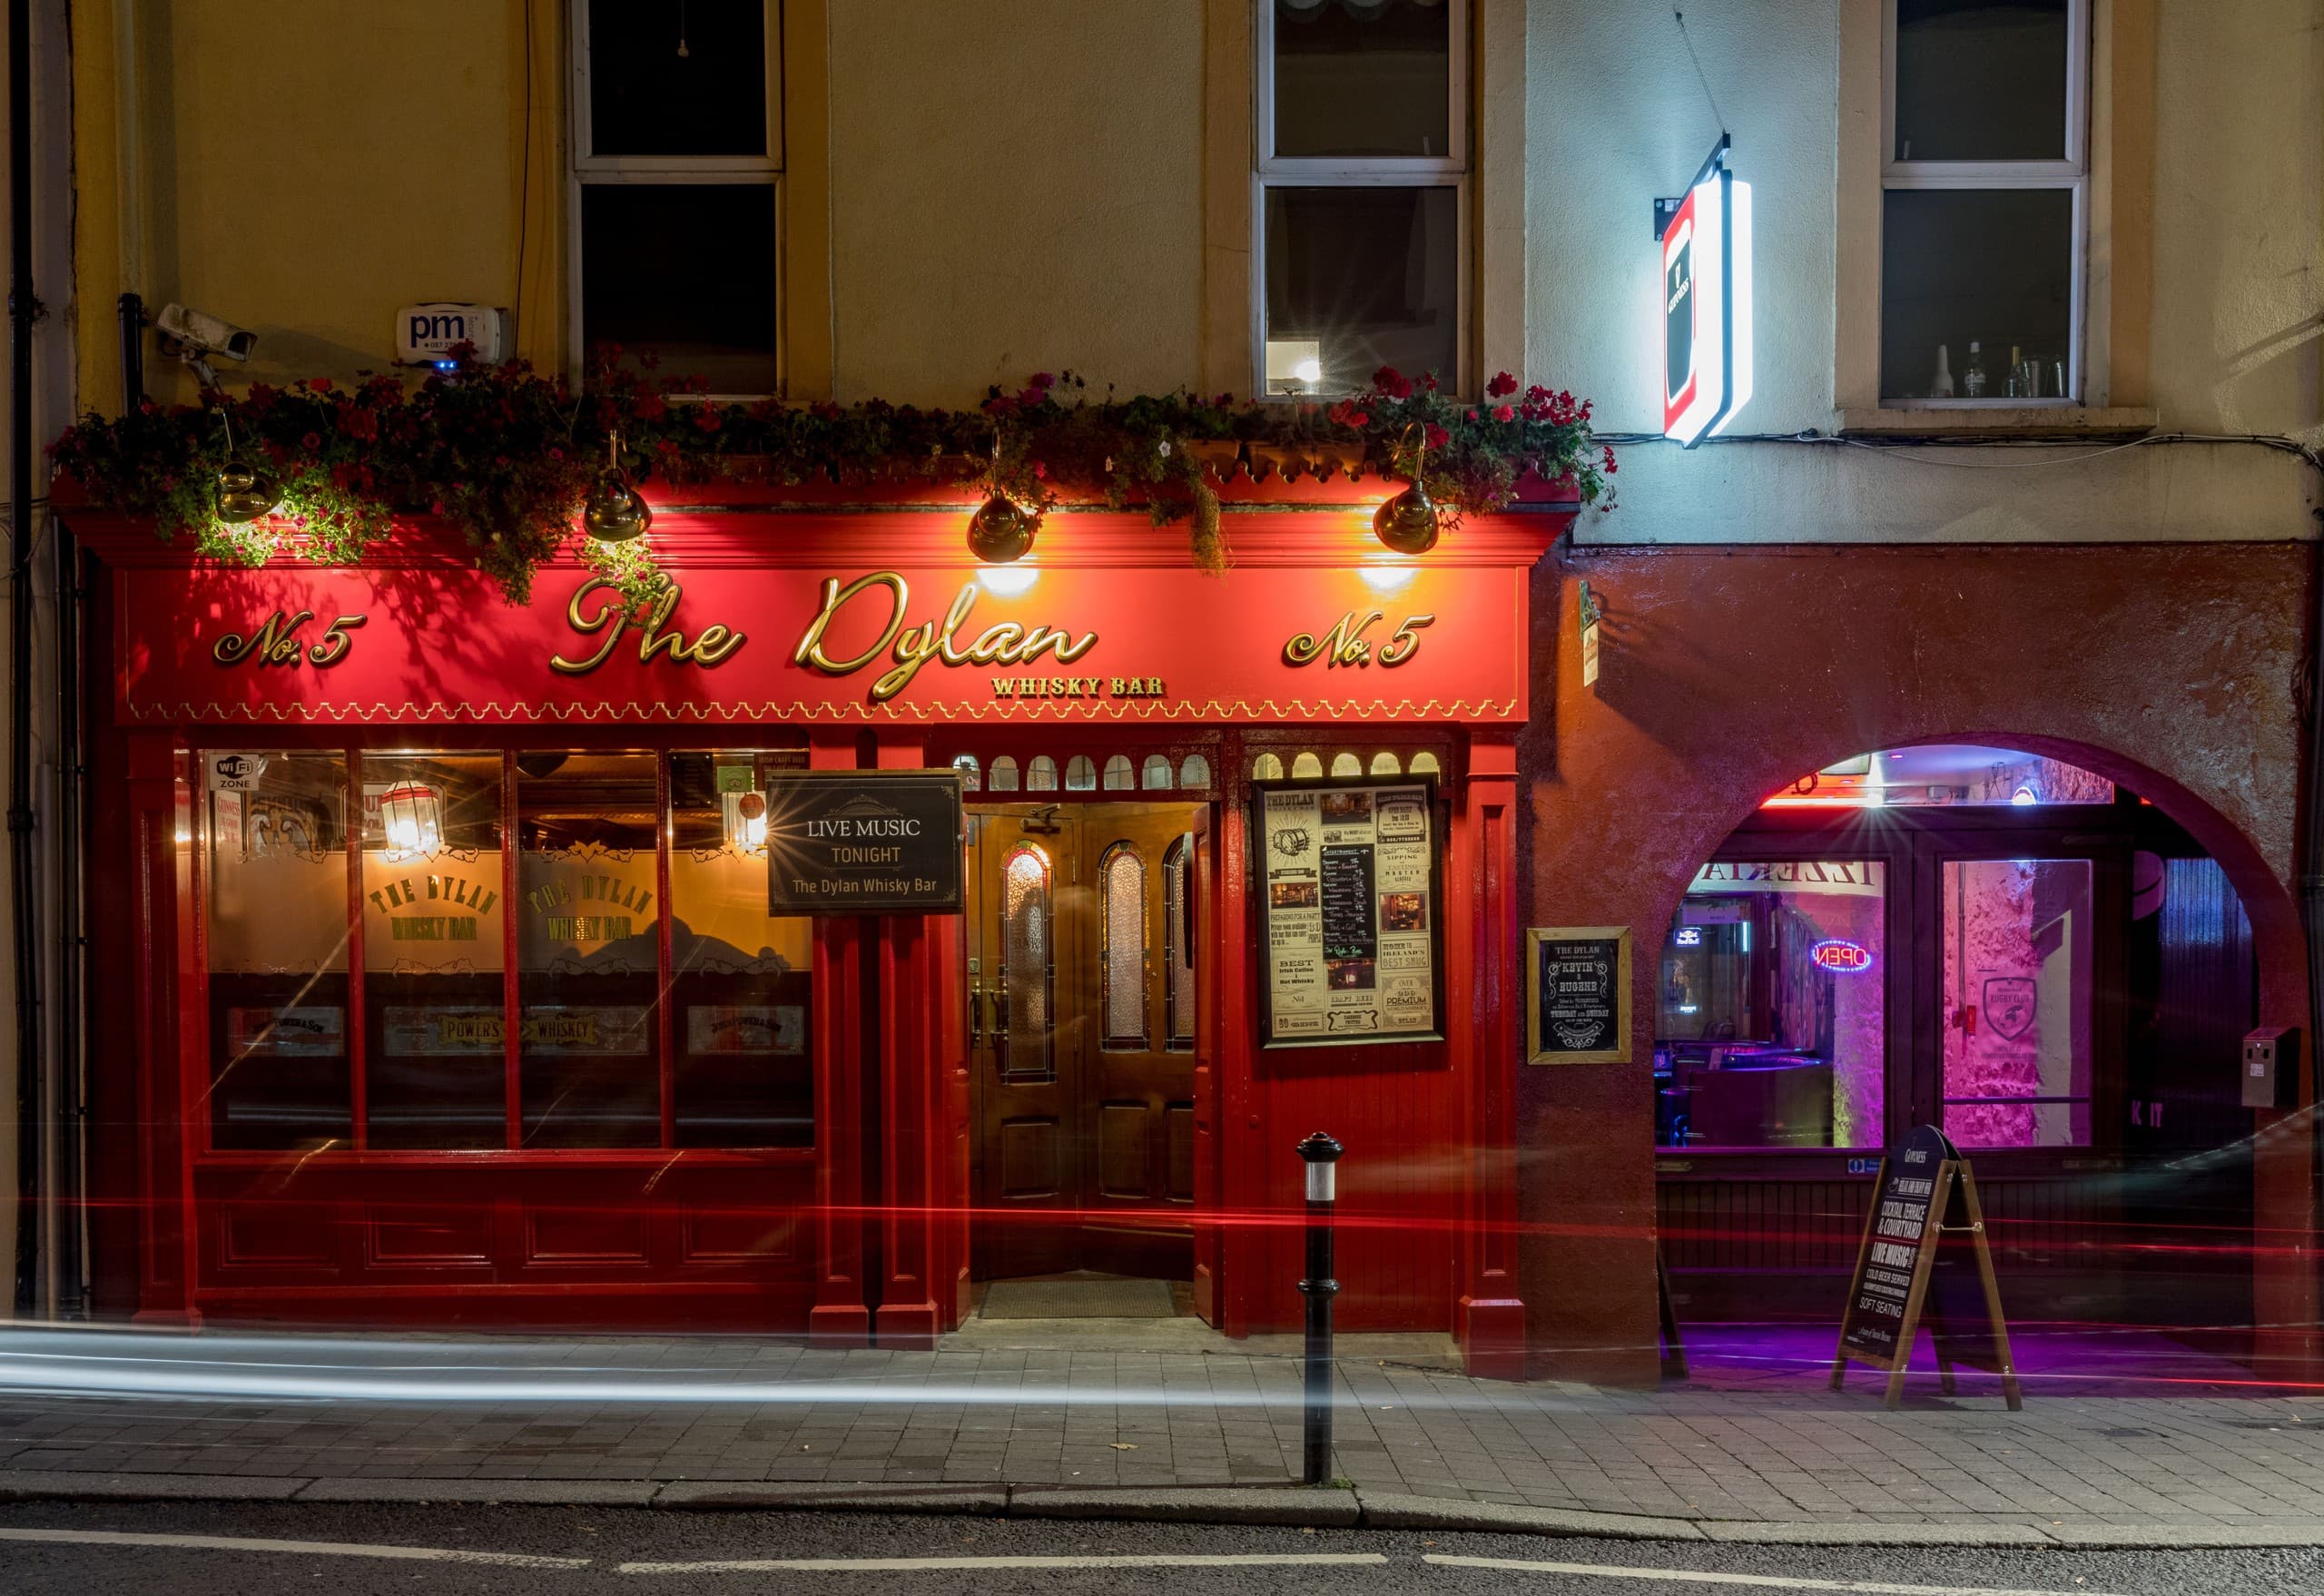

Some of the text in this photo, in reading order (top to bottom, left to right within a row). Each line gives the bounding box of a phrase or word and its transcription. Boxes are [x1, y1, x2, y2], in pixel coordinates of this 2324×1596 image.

[410, 315, 465, 348] pm
[213, 611, 367, 666] No. 5
[550, 571, 1098, 699] The Dylan
[1285, 610, 1435, 668] No. 5
[991, 677, 1165, 696] WHISKY BAR
[1266, 793, 1315, 807] THE DYLAN
[808, 819, 921, 837] LIVE MUSIC
[831, 846, 901, 863] TONIGHT
[369, 874, 498, 915] THE DYLAN
[527, 874, 654, 915] THE DYLAN
[793, 878, 937, 896] The Dylan Whisky Bar
[390, 916, 478, 941] WHISKY BAR
[603, 916, 633, 941] BAR
[1555, 946, 1600, 954] THE DYLAN
[1383, 957, 1403, 968] BEST
[1562, 962, 1593, 972] KEVIN
[1560, 981, 1598, 992] EUGENE
[1386, 997, 1426, 1005] PREMIUM
[1990, 994, 2030, 1002] RUGBY CLUB
[448, 1020, 589, 1039] POWER'S WHISKEY
[1905, 1148, 1928, 1164] GUINNESS
[1881, 1200, 1926, 1221] COCKTAIL TERRACE
[1877, 1217, 1923, 1239] & COURTYARD
[1871, 1242, 1888, 1264] LIVE
[1885, 1244, 1911, 1267] MUSIC
[1866, 1268, 1910, 1286] COLD BEER SERVED
[1859, 1296, 1903, 1318] SOFT SEATING
